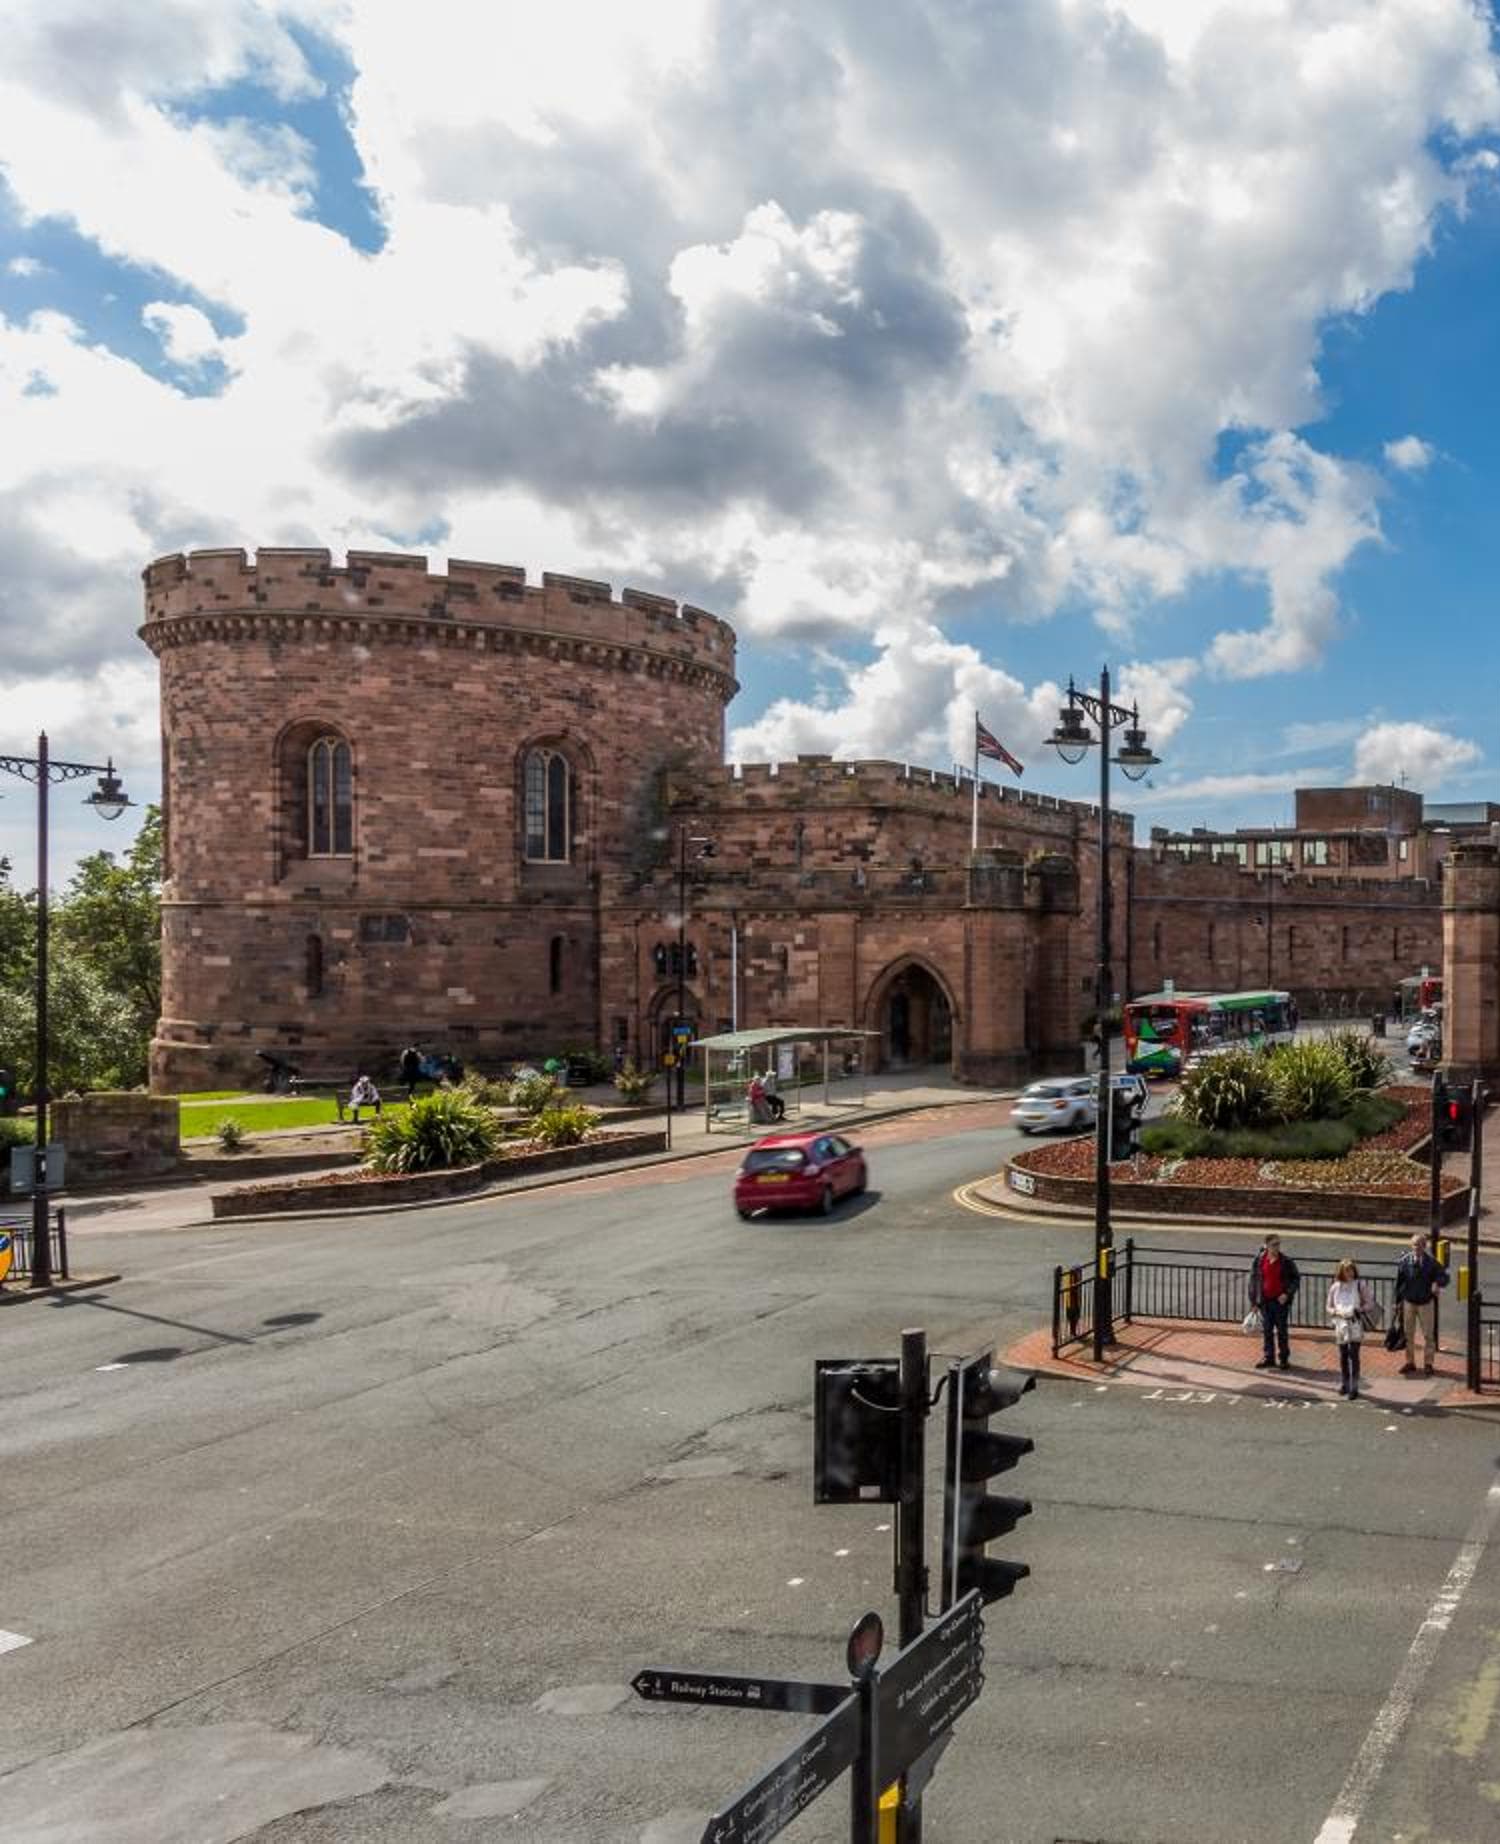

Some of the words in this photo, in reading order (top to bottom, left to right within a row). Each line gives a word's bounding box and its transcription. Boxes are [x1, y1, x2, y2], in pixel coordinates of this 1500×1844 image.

[1140, 1389, 1243, 1405] LEFT
[671, 1681, 707, 1698] Railway
[709, 1684, 744, 1698] Station
